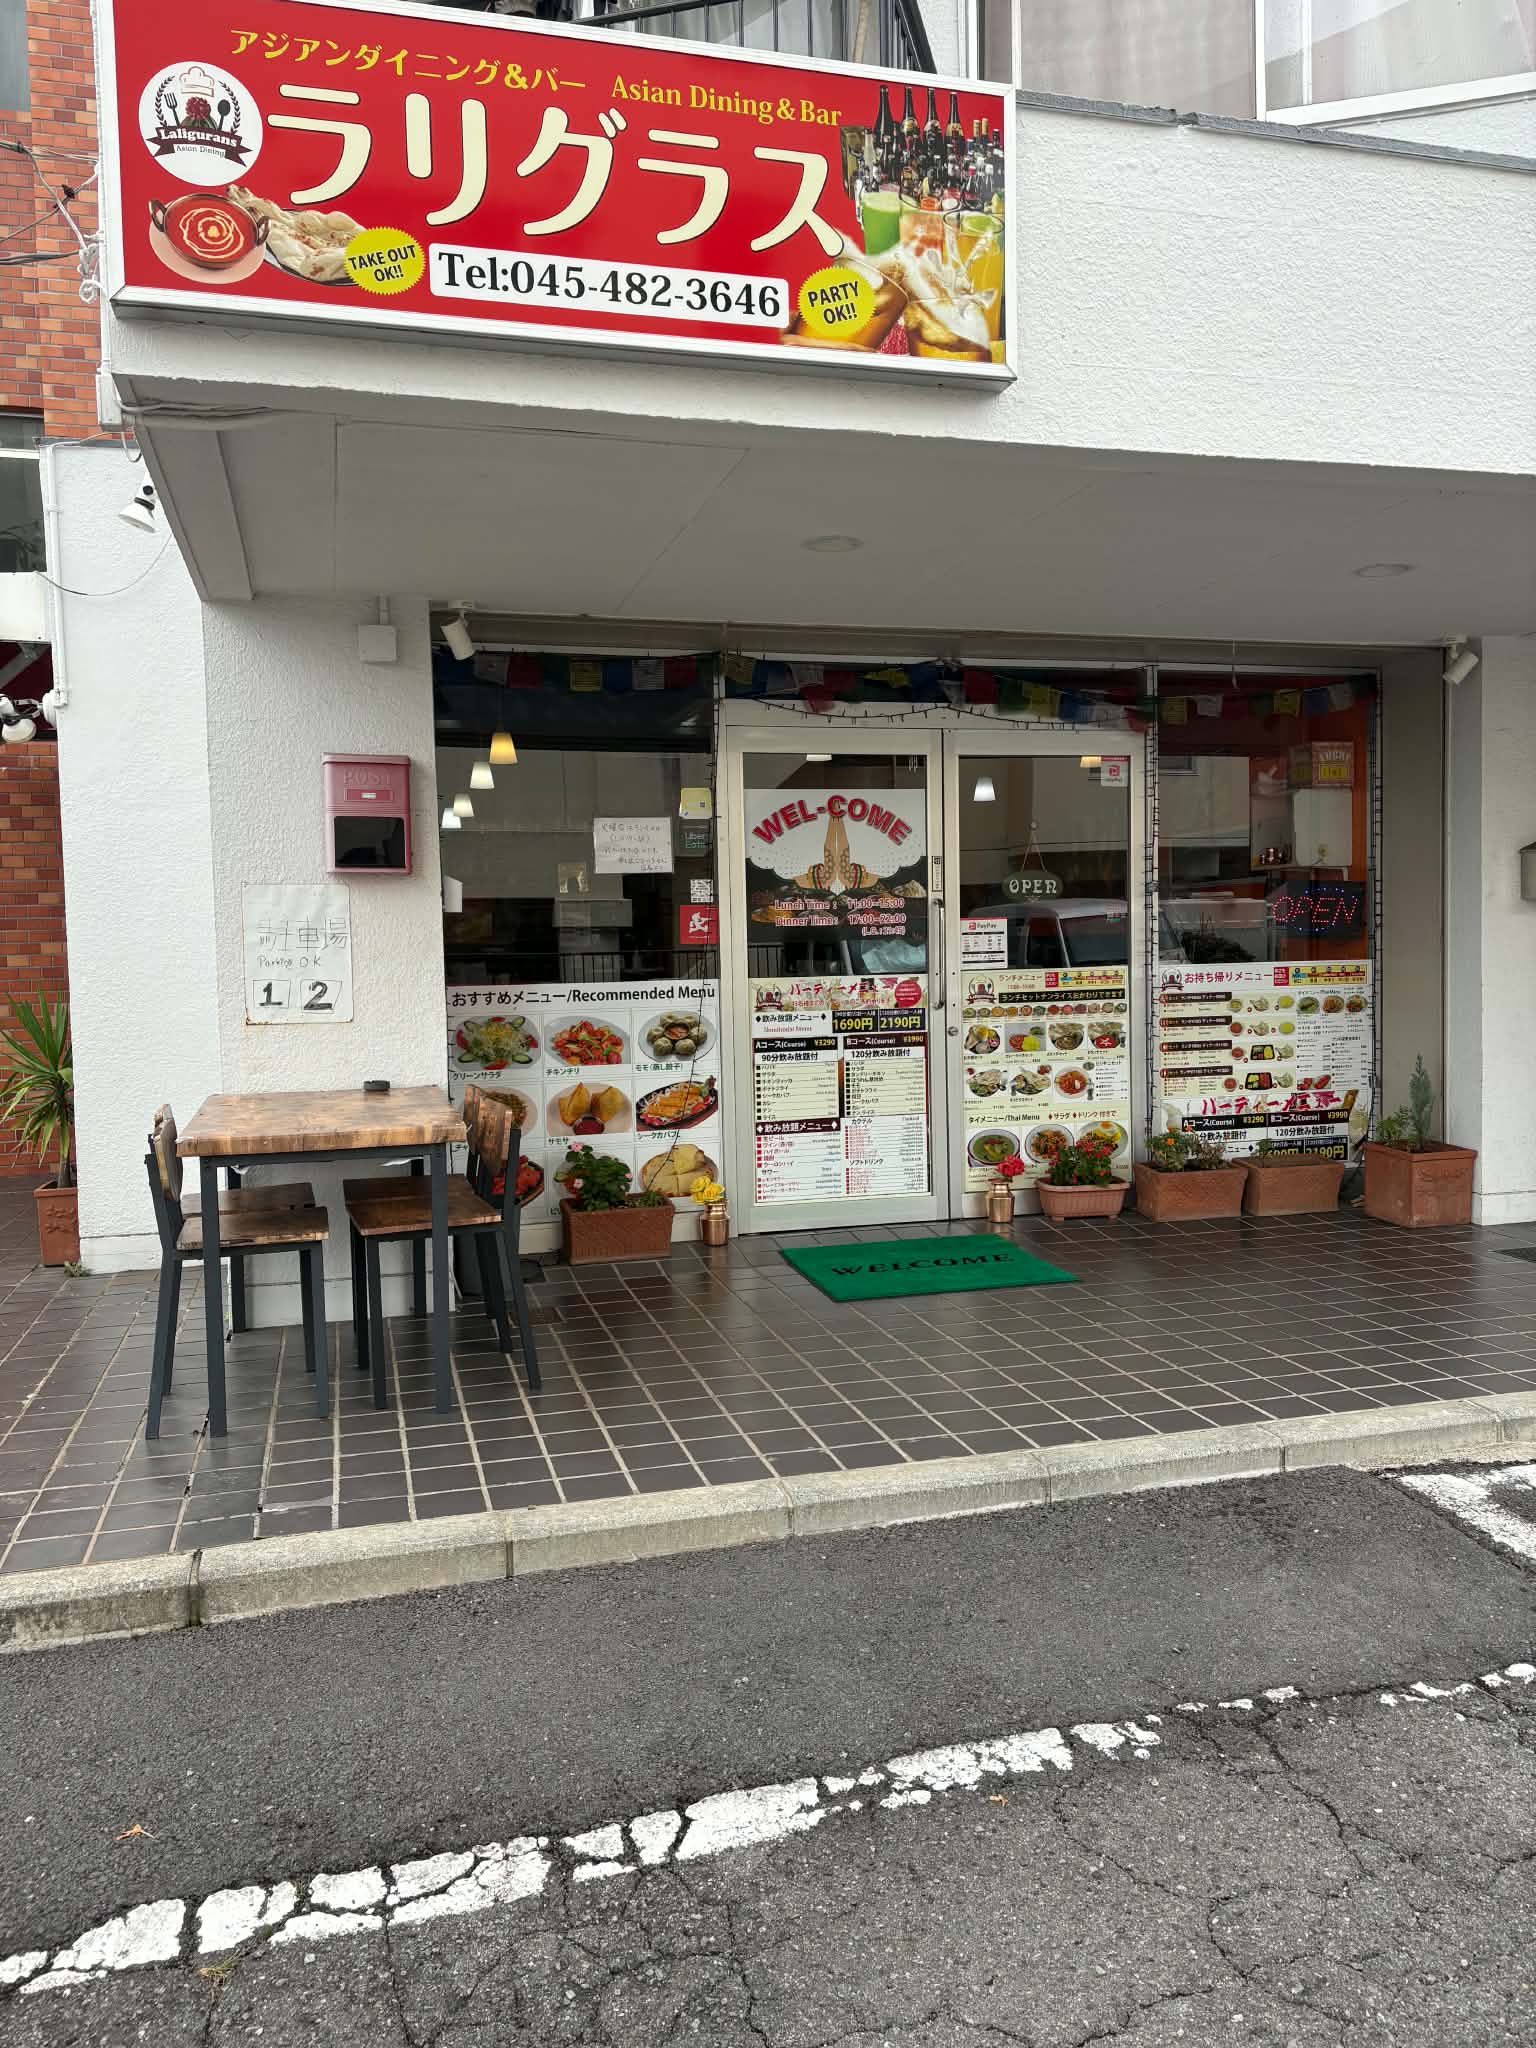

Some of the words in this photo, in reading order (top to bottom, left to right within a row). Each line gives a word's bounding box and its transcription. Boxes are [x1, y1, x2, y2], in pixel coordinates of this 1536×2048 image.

[230, 28, 586, 92] アジアンダイニング&バー
[611, 74, 682, 107] Asian
[157, 126, 239, 149] Laligurans
[174, 143, 198, 154] Asian
[199, 146, 226, 159] Dining
[267, 83, 845, 257] ラリグラス
[347, 253, 386, 273] TAKE
[387, 244, 418, 263] OUT
[373, 264, 404, 284] OK!!
[438, 251, 780, 318] Tel:045-482-3646
[807, 280, 861, 307] PARTY
[822, 303, 857, 325] OK!!
[752, 795, 912, 846] WEL-COME
[1008, 879, 1057, 894] OPEN
[775, 899, 805, 911] Lunch
[1272, 895, 1358, 924] OPEN
[775, 915, 808, 927] Dinner
[259, 981, 283, 1007] 1
[303, 981, 333, 1011] 2
[679, 986, 715, 999] Menu
[833, 1017, 874, 1031] 1690円
[879, 1016, 921, 1029] 2190円
[1201, 1090, 1342, 1116] パーティーメニュー
[832, 1253, 1013, 1276] WELCOME
